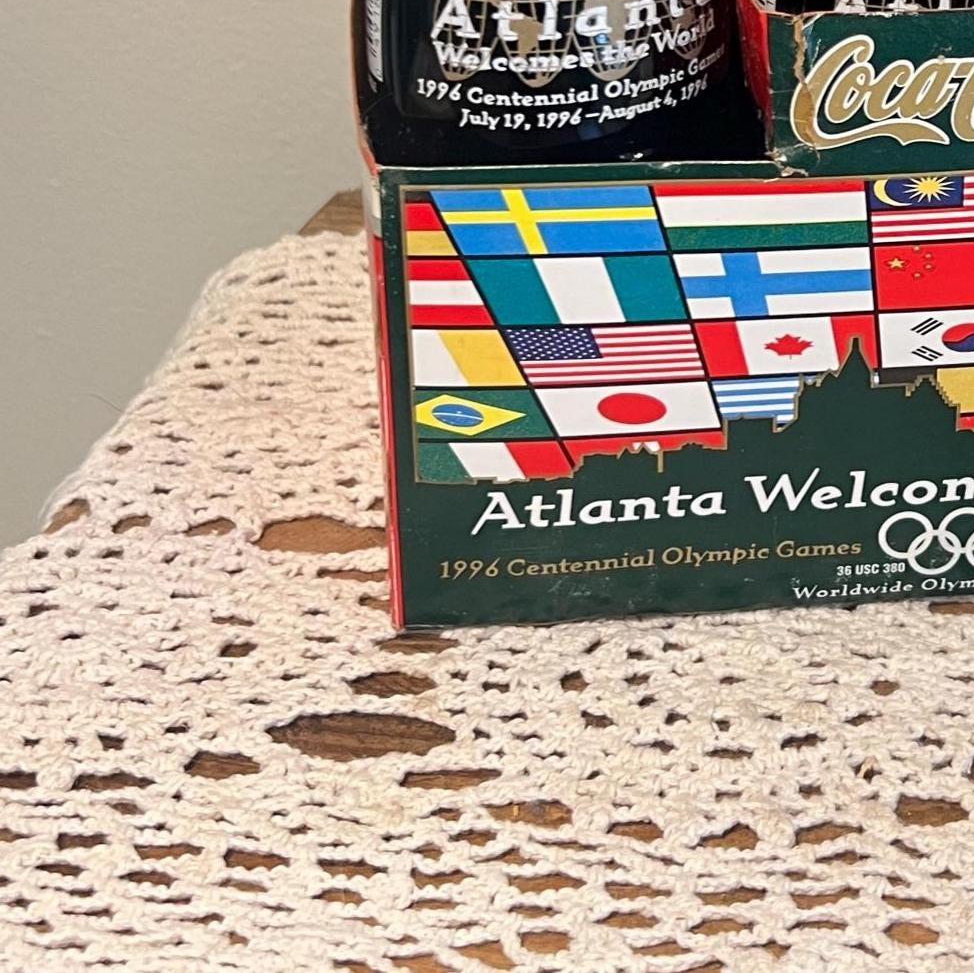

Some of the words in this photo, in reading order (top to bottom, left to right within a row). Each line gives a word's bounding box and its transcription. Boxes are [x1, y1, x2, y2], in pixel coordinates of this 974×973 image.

[431, 41, 594, 73] Welcomes
[600, 40, 650, 64] the
[652, 9, 715, 53] World
[417, 78, 461, 102] 1996
[467, 84, 599, 108] Centennial
[604, 68, 685, 99] Olympic
[459, 108, 500, 130] July
[504, 112, 531, 131] 19,
[537, 108, 583, 129] 1996
[662, 91, 678, 108] 4,
[681, 73, 708, 101] 1996
[471, 486, 726, 536] Atlanta
[439, 557, 501, 581] 1996
[507, 549, 655, 576] Centennial
[662, 542, 770, 567] Olympic
[777, 539, 863, 560] Games
[836, 565, 852, 576] 36
[855, 564, 880, 575] USC
[883, 561, 906, 574] 380
[793, 578, 914, 600] Worldwide
